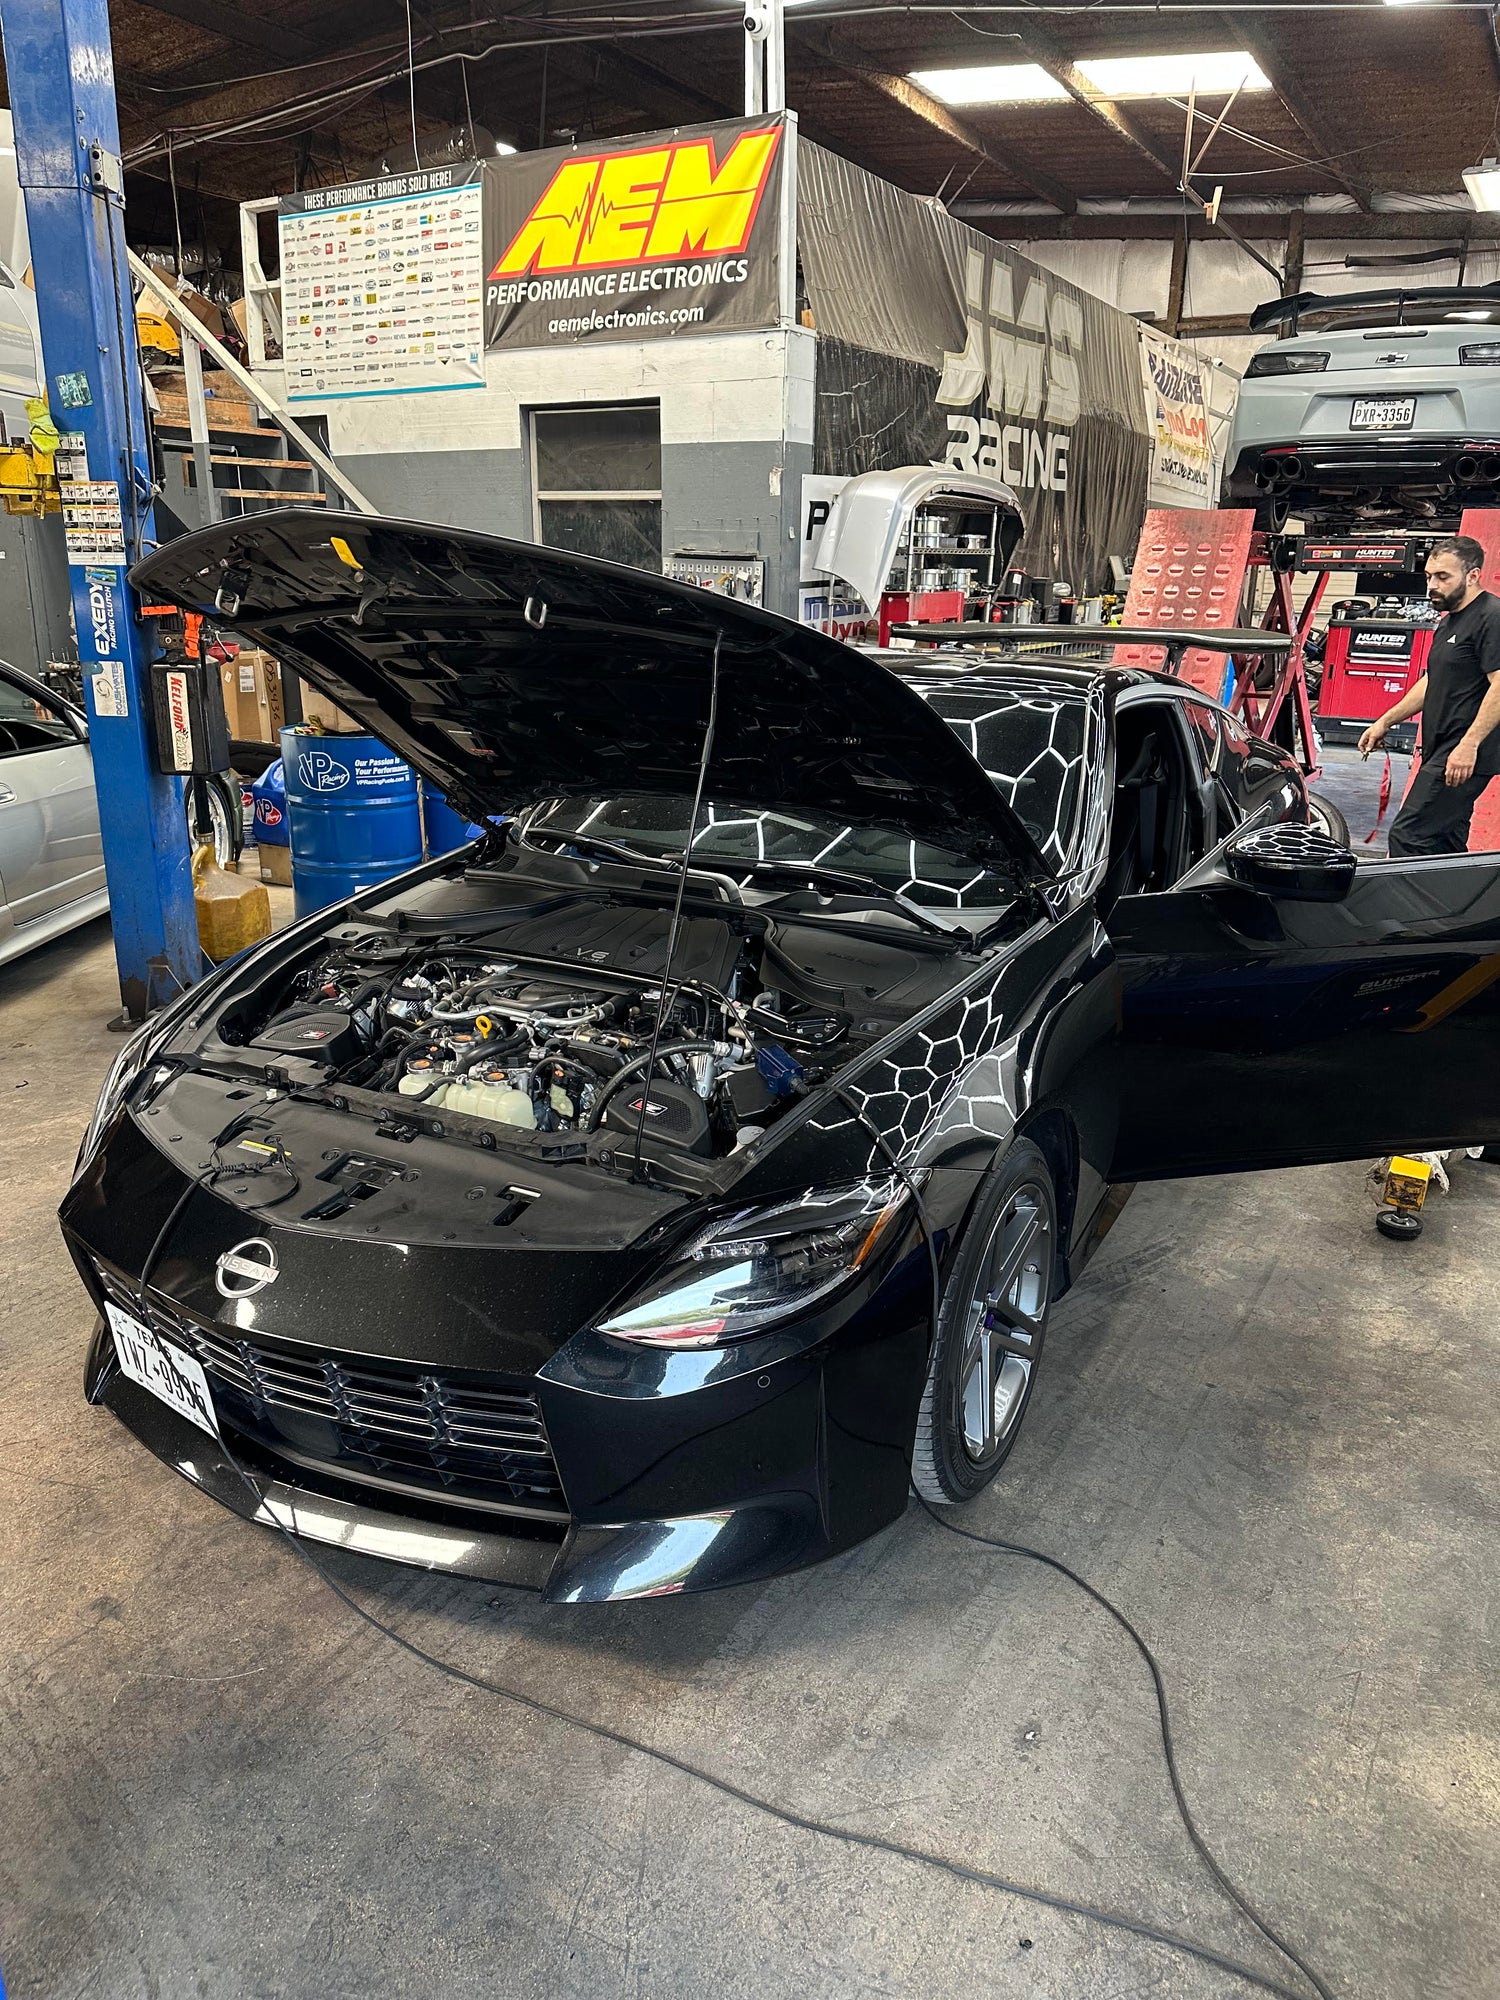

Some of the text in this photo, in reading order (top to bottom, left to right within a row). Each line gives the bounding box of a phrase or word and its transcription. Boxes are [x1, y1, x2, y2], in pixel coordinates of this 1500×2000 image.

[304, 170, 452, 209] THESE PERFORMANCE BRANDS SOLD HERE!
[488, 127, 783, 280] AEM
[487, 259, 748, 306] PERFORMANCE ELECTRONICS
[548, 306, 704, 333] aemelectronics.com
[935, 246, 1084, 427] JMS
[89, 582, 110, 655] EXEDY
[105, 586, 118, 650] RACING CLUTCH
[1356, 633, 1407, 643] HUNTER
[170, 676, 188, 767] KELFORD CAMS
[298, 751, 333, 790] VP
[321, 772, 348, 786] Racing
[369, 758, 394, 766] Passion
[577, 947, 610, 960] V6
[218, 1253, 277, 1282] NISSAN
